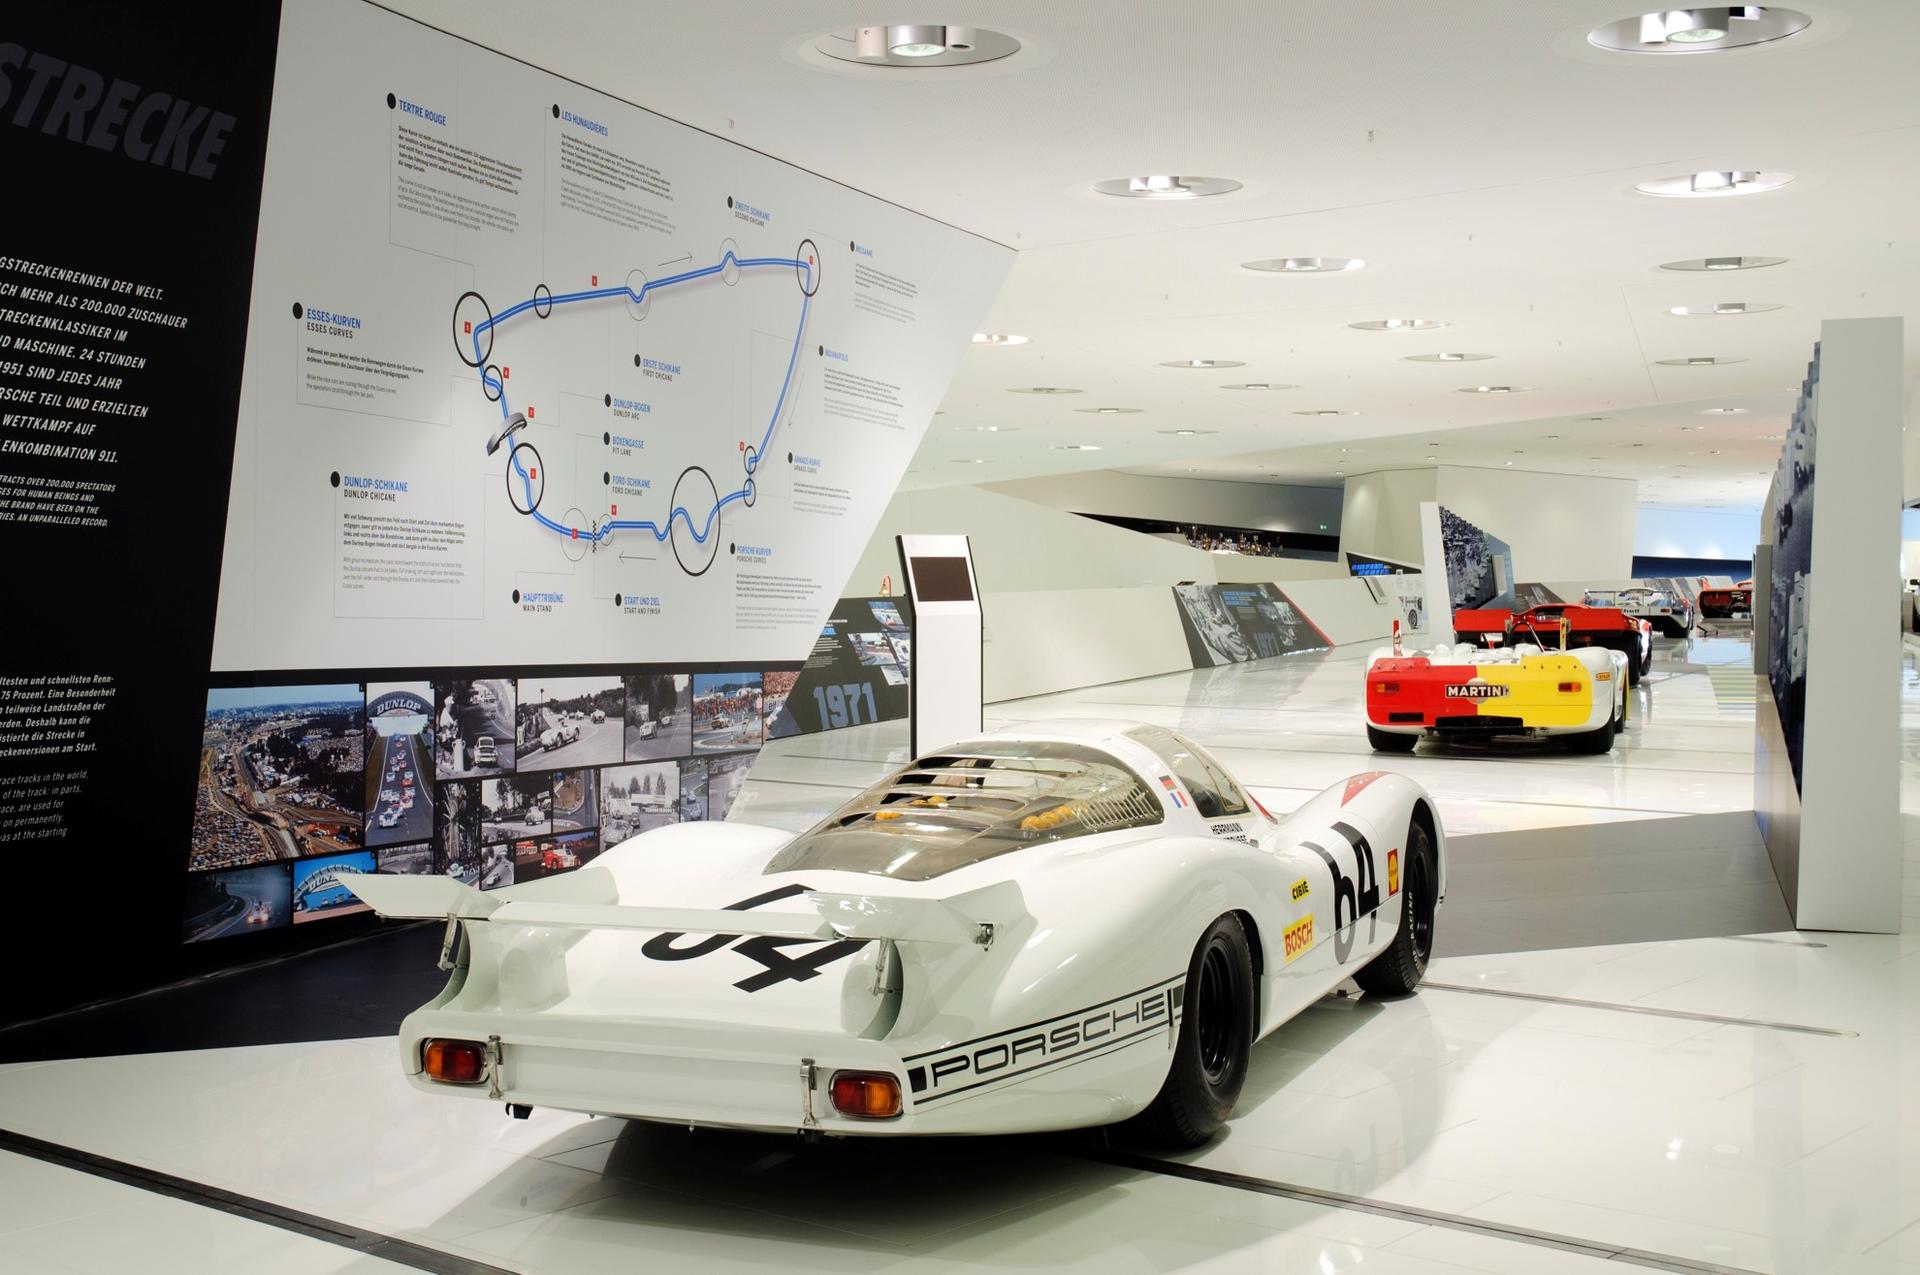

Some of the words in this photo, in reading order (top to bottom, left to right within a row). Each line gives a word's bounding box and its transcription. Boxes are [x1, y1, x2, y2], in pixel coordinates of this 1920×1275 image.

[398, 99, 424, 119] TERTRE
[425, 109, 447, 126] ROUGE
[561, 111, 572, 122] LES
[0, 256, 110, 290] GSTRECKENRENNEN
[112, 279, 133, 295] DER
[135, 285, 164, 301] WELT.
[0, 282, 18, 297] CH
[20, 286, 54, 304] MEHR
[55, 294, 78, 308] ALS
[80, 298, 126, 318] 200.000
[127, 307, 188, 329] ZUSCHAUER
[0, 308, 112, 341] TRECKENKLASSIKER
[113, 328, 129, 343] IM
[306, 308, 361, 329] ESSES-KURVEN
[306, 322, 328, 335] ESSES
[328, 326, 353, 339] CURVES
[13, 337, 76, 359] MASCHINE.
[79, 348, 96, 361] 24
[96, 351, 147, 370] STUNDEN
[26, 365, 55, 381] SIND
[57, 370, 93, 386] JEDES
[93, 377, 123, 390] JAHR
[38, 392, 63, 407] TEIL
[65, 396, 90, 411] UND
[91, 400, 149, 419] ERZIELTEN
[2, 413, 74, 434] WETTKAMPF
[73, 423, 97, 437] AUF
[98, 450, 118, 464] 911.
[26, 477, 46, 487] OVER
[75, 482, 116, 493] SPECTATORS
[344, 475, 409, 493] DUNLOP-SCHIKANE
[12, 488, 27, 498] FOR
[27, 490, 53, 500] HUMAN
[54, 492, 79, 502] BEINGS
[79, 494, 95, 503] AND
[343, 489, 369, 500] DUNLOP
[369, 491, 396, 503] CHICANE
[11, 501, 36, 511] BRAND
[36, 503, 56, 512] HAVE
[55, 504, 74, 513] BEEN
[74, 505, 86, 514] ON
[86, 506, 100, 515] THE
[16, 513, 28, 522] AN
[28, 514, 81, 526] UNPARALLELED
[523, 605, 536, 613] MAIN
[536, 605, 553, 614] STAND
[30, 675, 46, 686] und
[47, 675, 92, 686] schnellsten
[92, 674, 114, 684] Renn-
[1, 690, 11, 701] 75
[12, 689, 46, 700] Prozent.
[47, 688, 65, 699] Eine
[66, 687, 117, 699] Besonderheit
[5, 703, 42, 715] teilweise
[92, 701, 107, 712] der
[376, 698, 421, 715] DUNLOP
[812, 682, 878, 732] 1971
[25, 716, 57, 728] Deshalb
[58, 717, 77, 727] kann
[78, 715, 91, 725] die
[31, 731, 44, 741] die
[45, 730, 76, 741] Strecke
[77, 729, 86, 739] in
[61, 745, 74, 754] am
[75, 742, 97, 753] Start.
[17, 773, 42, 785] tracks
[42, 773, 51, 782] in
[52, 771, 65, 782] the
[2, 789, 12, 800] of
[12, 789, 26, 799] the
[51, 787, 59, 796] in
[18, 803, 32, 813] are
[33, 800, 52, 812] used
[53, 799, 65, 809] for
[3, 819, 13, 828] on
[12, 831, 22, 842] at
[22, 830, 37, 841] the
[37, 827, 68, 840] starting
[1298, 821, 1380, 966] 64
[1283, 920, 1313, 957] BOSCH
[931, 992, 1165, 1087] PORSCHE
